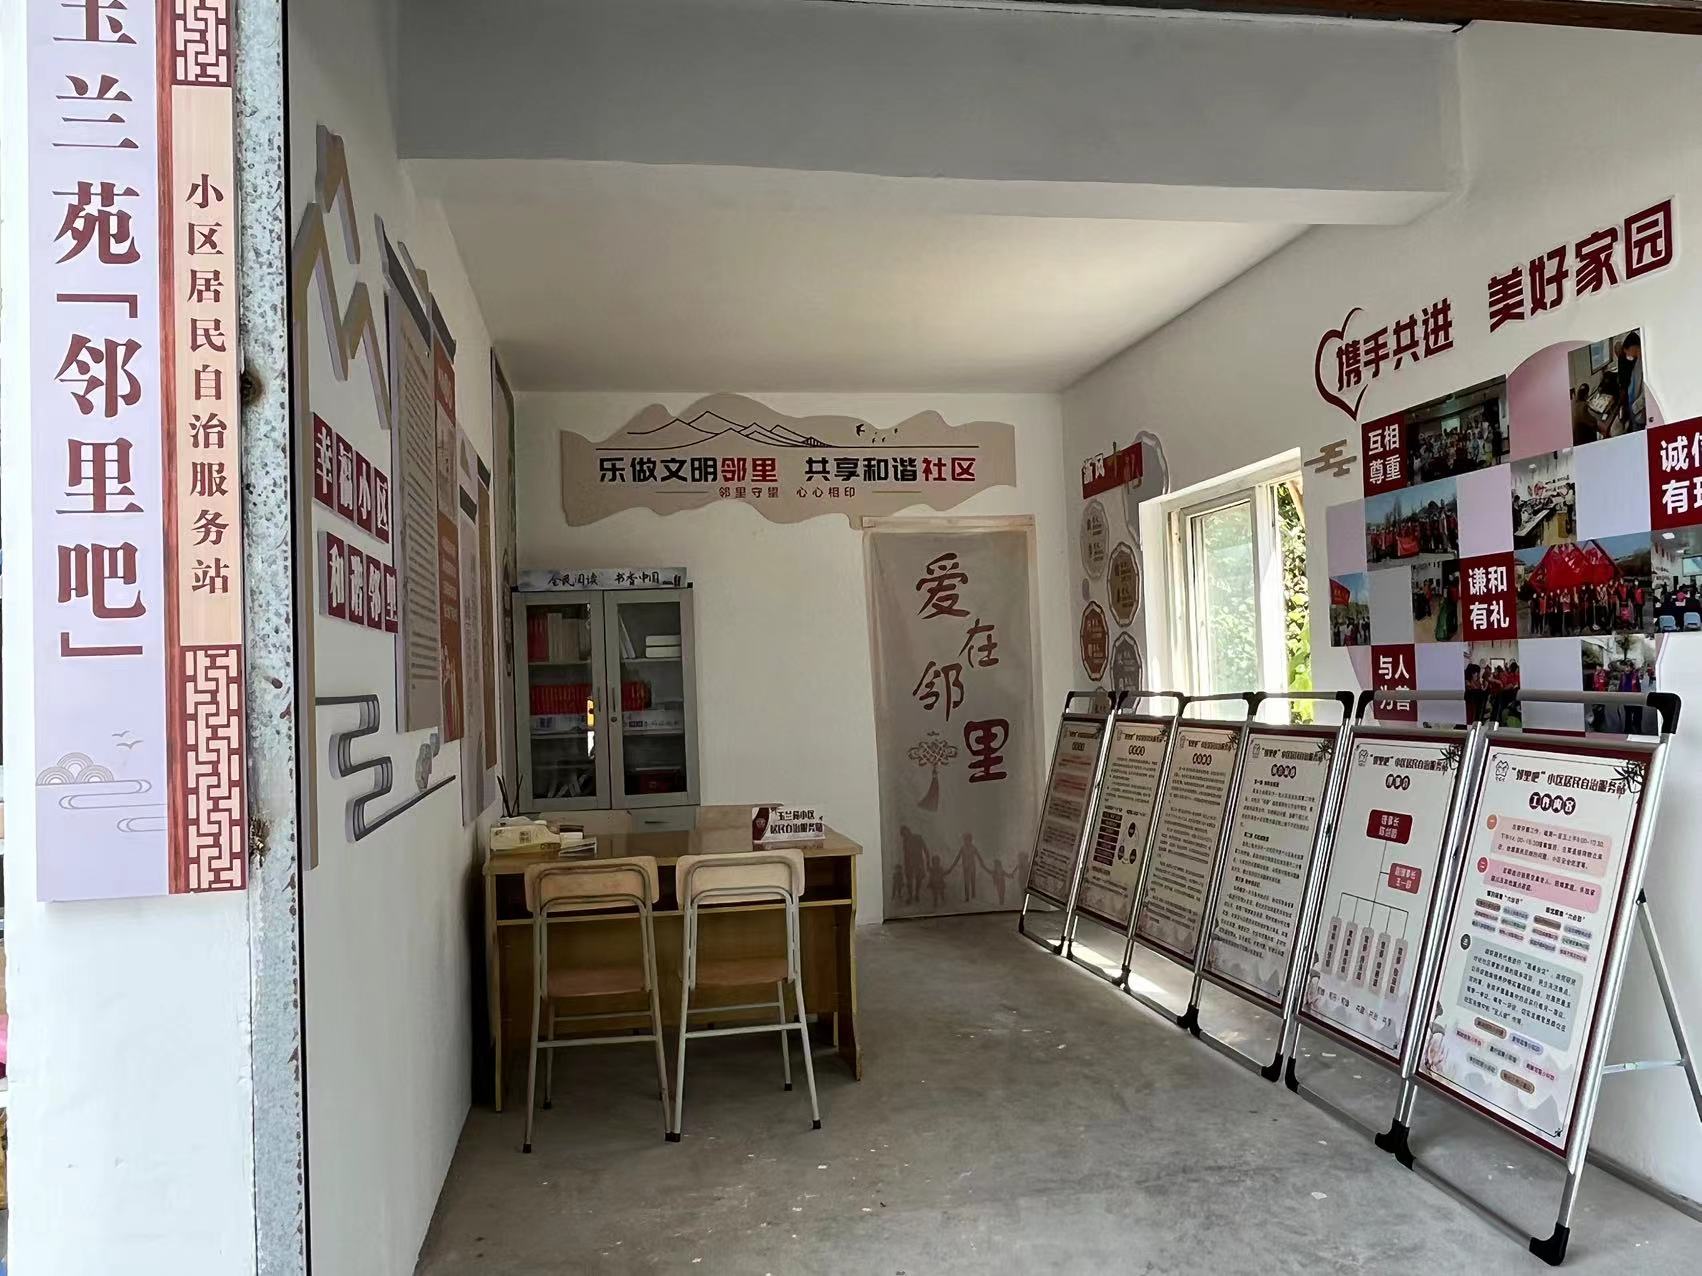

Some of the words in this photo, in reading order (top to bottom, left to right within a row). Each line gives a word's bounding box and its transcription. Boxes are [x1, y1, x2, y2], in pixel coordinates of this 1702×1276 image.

[1336, 297, 1454, 392] 携手共进
[1487, 199, 1673, 333] 美好家园
[185, 173, 229, 594] 小区居民自治服务站
[1368, 424, 1400, 453] 互相
[315, 426, 389, 532] 幸福小区
[598, 457, 778, 483] 乐做文明邻里
[804, 457, 977, 482] 共享和谐社区
[1369, 455, 1401, 485] 尊重
[796, 486, 856, 499] 心心相印
[329, 544, 398, 622] 和谐邻里
[1468, 566, 1507, 594] 谦和
[1469, 600, 1510, 631] 有礼
[912, 552, 1010, 783] 爱在邻里
[1378, 654, 1410, 680] 与人
